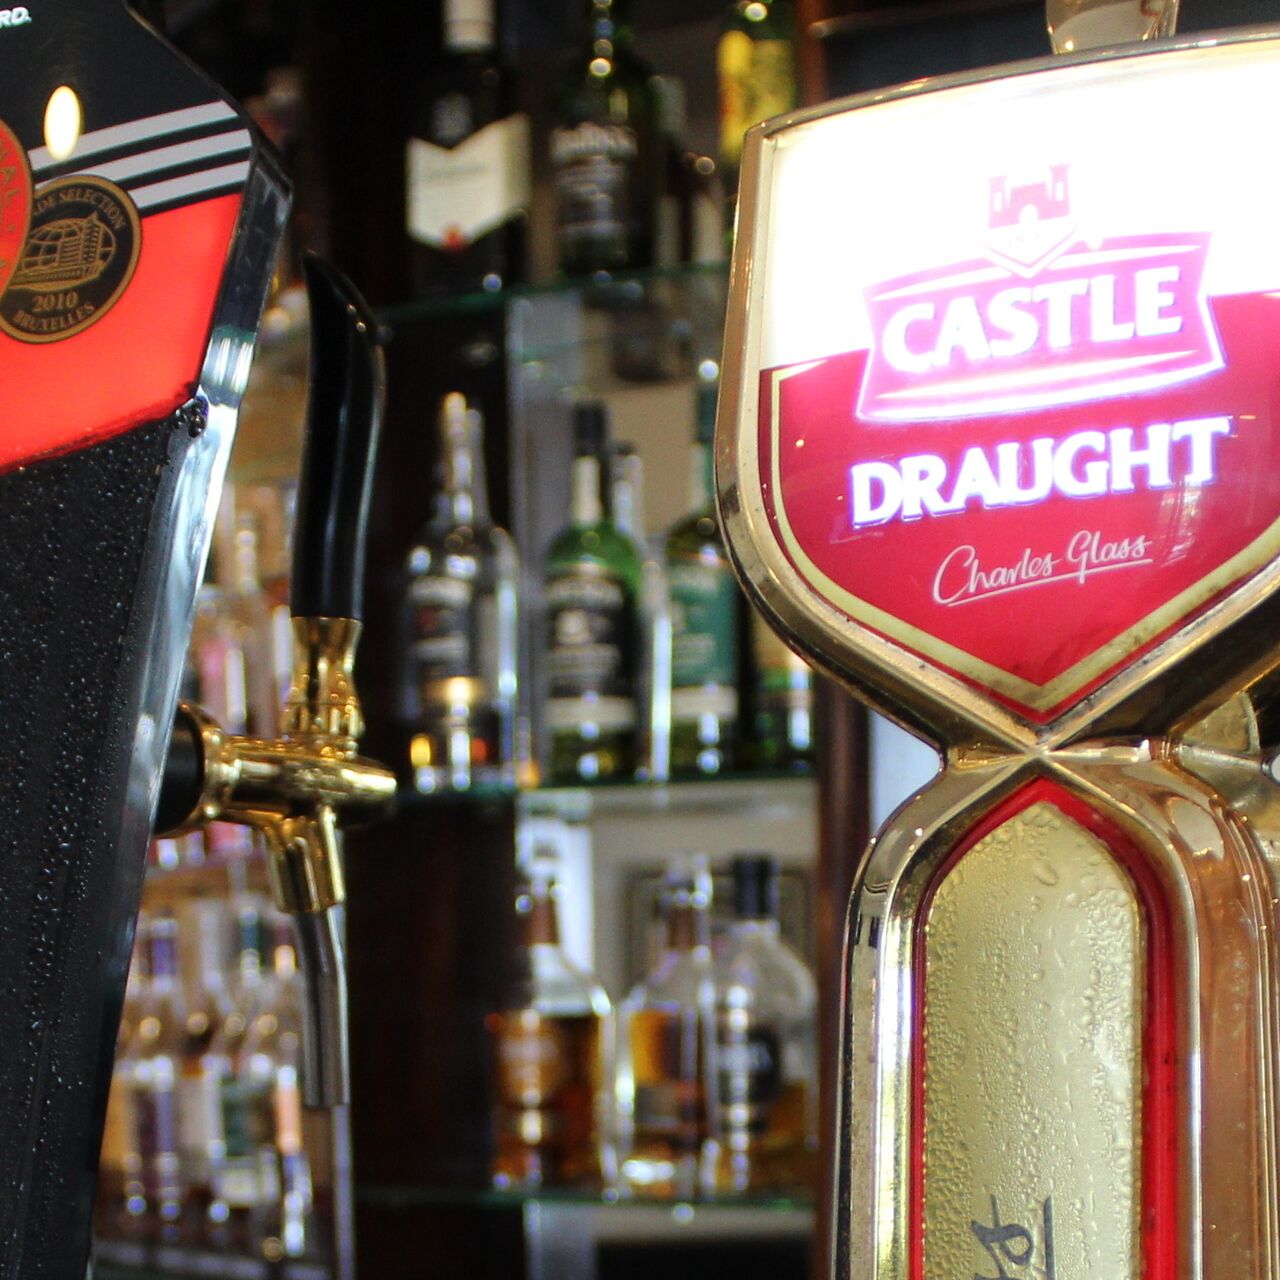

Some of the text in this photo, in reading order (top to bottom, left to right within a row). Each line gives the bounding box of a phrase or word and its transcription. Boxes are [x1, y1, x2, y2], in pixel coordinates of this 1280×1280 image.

[59, 188, 127, 230] SELECTION
[13, 302, 96, 331] BRUXELLES
[32, 290, 78, 314] 2010
[882, 264, 1182, 373] CASTLE
[850, 416, 1231, 530] DRAUGHT
[932, 530, 1153, 606] Charles Glass
